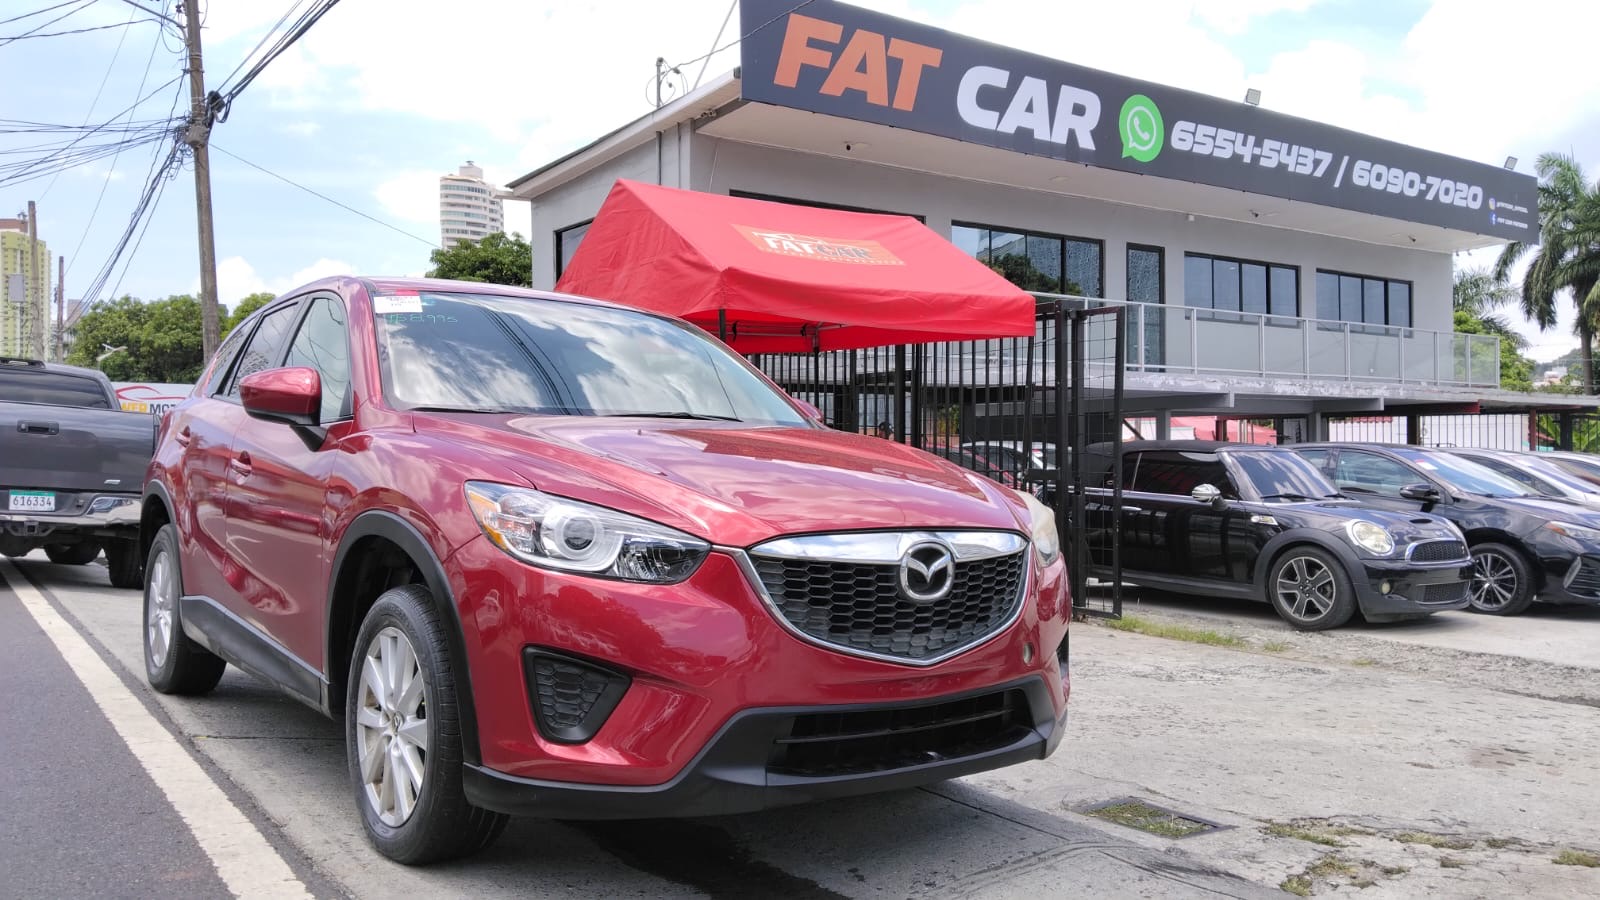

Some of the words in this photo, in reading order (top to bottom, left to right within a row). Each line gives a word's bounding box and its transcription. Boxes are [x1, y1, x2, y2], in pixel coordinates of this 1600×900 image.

[773, 13, 943, 112] FAT
[956, 66, 1101, 150] CAR
[1171, 120, 1333, 178] 6554-5437
[1352, 160, 1483, 210] 6090-7020
[13, 495, 52, 507] 616334
